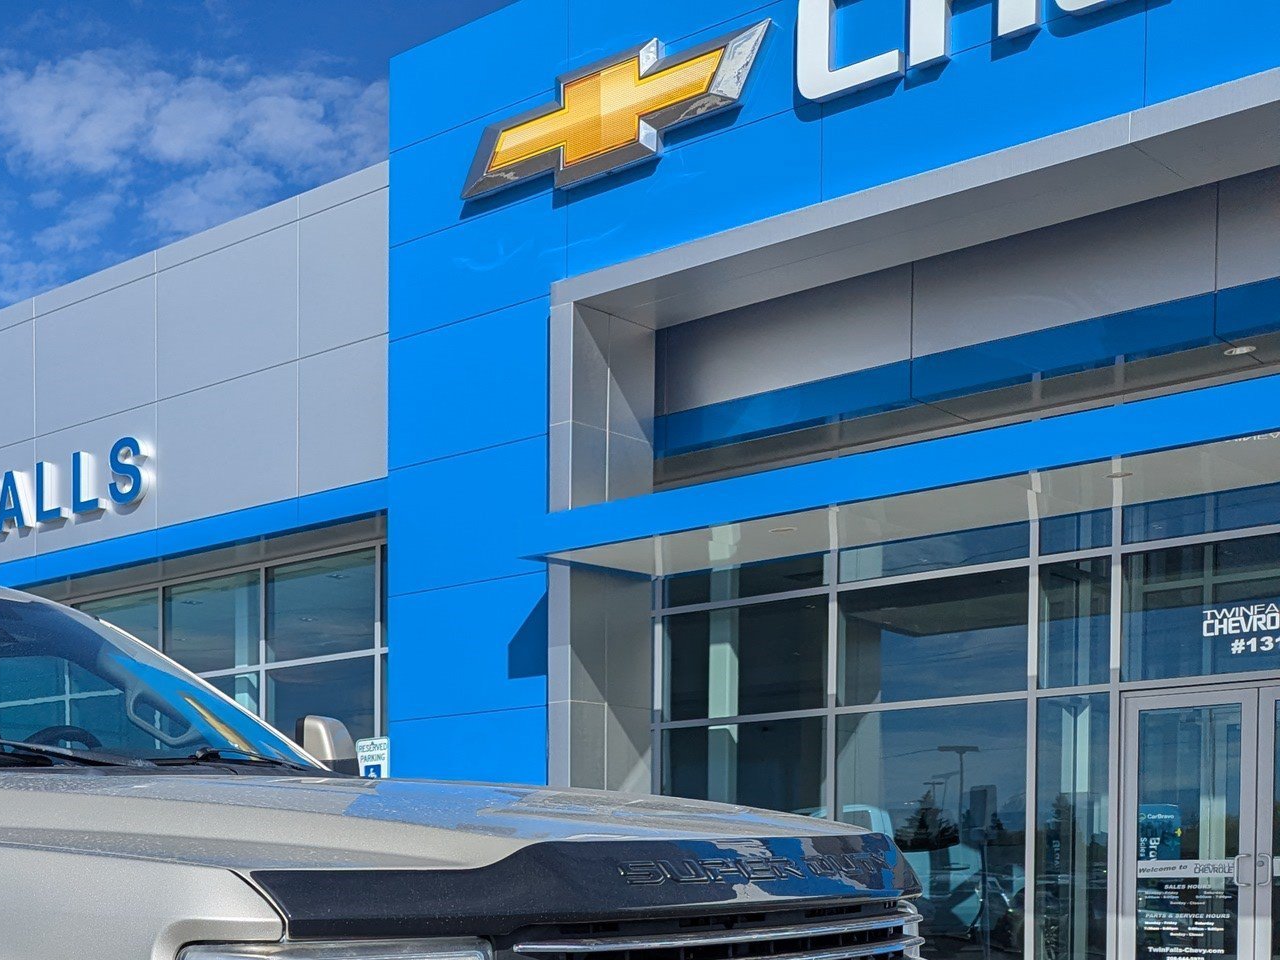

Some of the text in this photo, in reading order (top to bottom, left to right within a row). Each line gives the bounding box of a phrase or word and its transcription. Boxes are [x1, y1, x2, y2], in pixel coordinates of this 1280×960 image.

[1203, 603, 1280, 620] TWINFA
[1203, 613, 1280, 637] CHEVRO
[358, 743, 387, 752] RESERVED
[360, 754, 385, 763] PARKING
[617, 851, 894, 886] SUPER DUTY
[1139, 865, 1177, 874] Welcome
